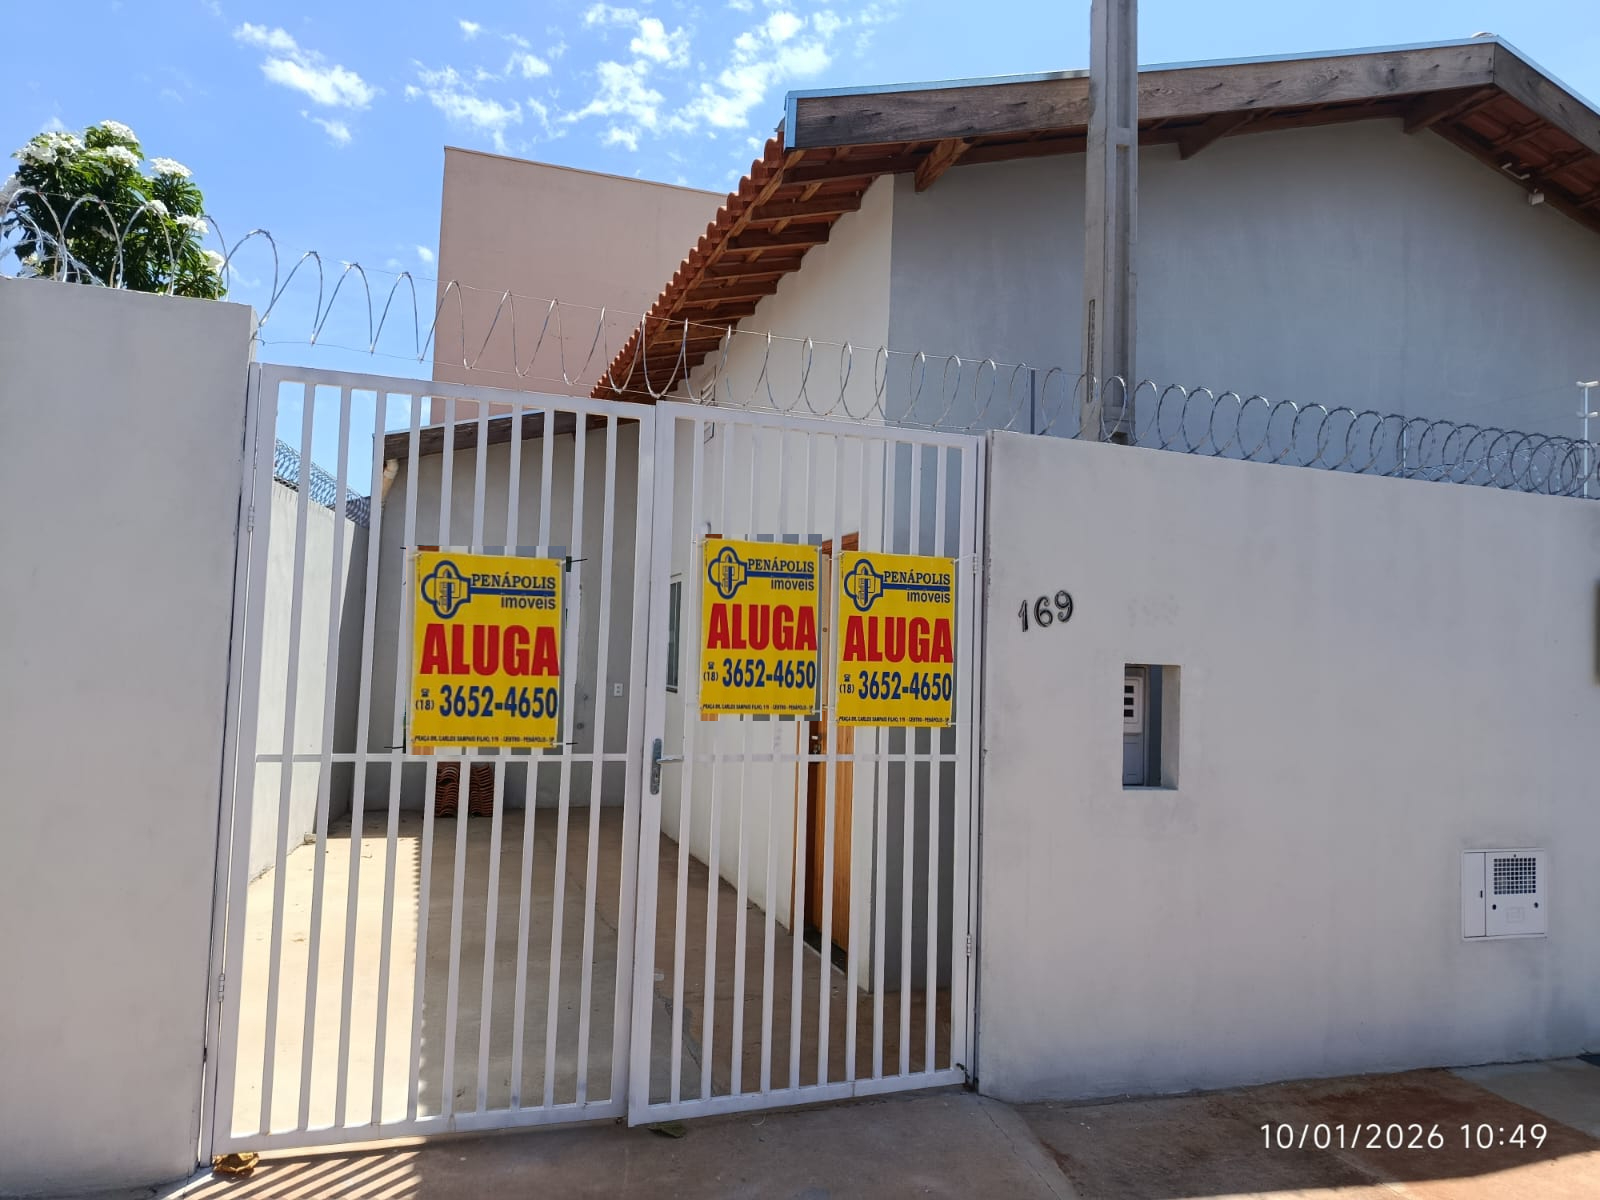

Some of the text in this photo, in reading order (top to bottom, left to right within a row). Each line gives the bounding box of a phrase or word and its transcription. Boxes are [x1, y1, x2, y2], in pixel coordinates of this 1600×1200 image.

[472, 571, 556, 589] PENÁPOLIS
[747, 557, 814, 573] PENÁPOLIS
[884, 569, 950, 585] PENÁPOLIS
[707, 603, 818, 651] ALUGA
[1018, 590, 1074, 632] 169
[420, 623, 559, 676] ALUGA
[843, 616, 954, 663] ALUGA
[703, 658, 816, 689] (18) 3652-4650
[839, 670, 952, 701] (18) 3652-4650
[416, 684, 558, 719] (18) 3652-4650
